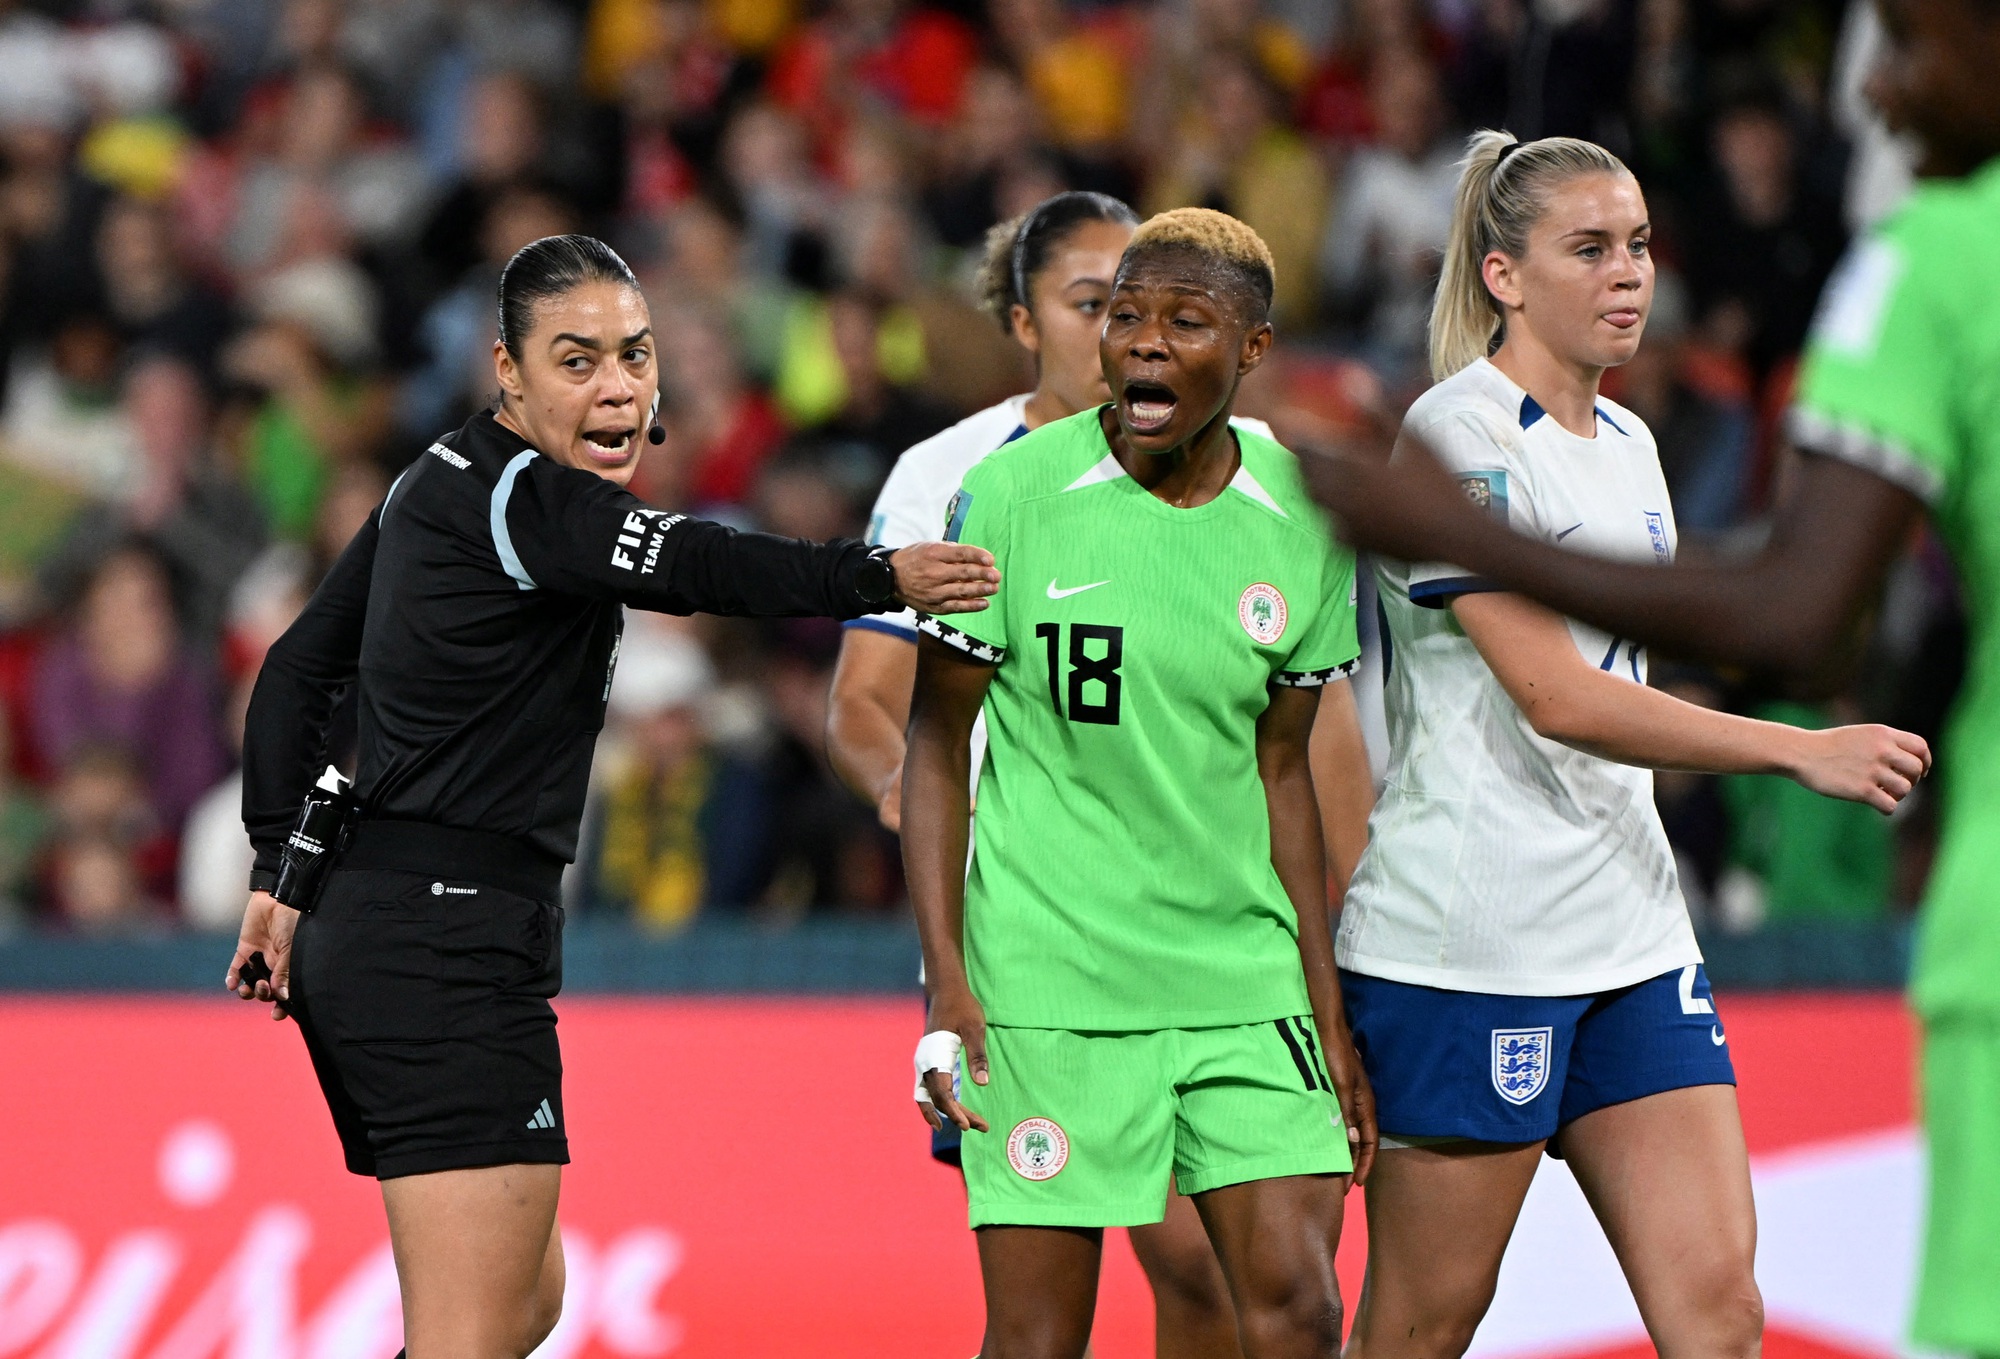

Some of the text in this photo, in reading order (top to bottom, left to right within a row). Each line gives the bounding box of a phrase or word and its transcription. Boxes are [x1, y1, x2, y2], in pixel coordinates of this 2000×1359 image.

[611, 509, 668, 571] FIFA
[641, 514, 688, 574] TEAM ONE
[1244, 586, 1273, 600] FOOTBALL
[1035, 622, 1124, 726] 18
[1678, 964, 1715, 1015] 2
[1013, 1120, 1047, 1140] FOOTBALL
[1048, 1124, 1066, 1168] FEDERATION
